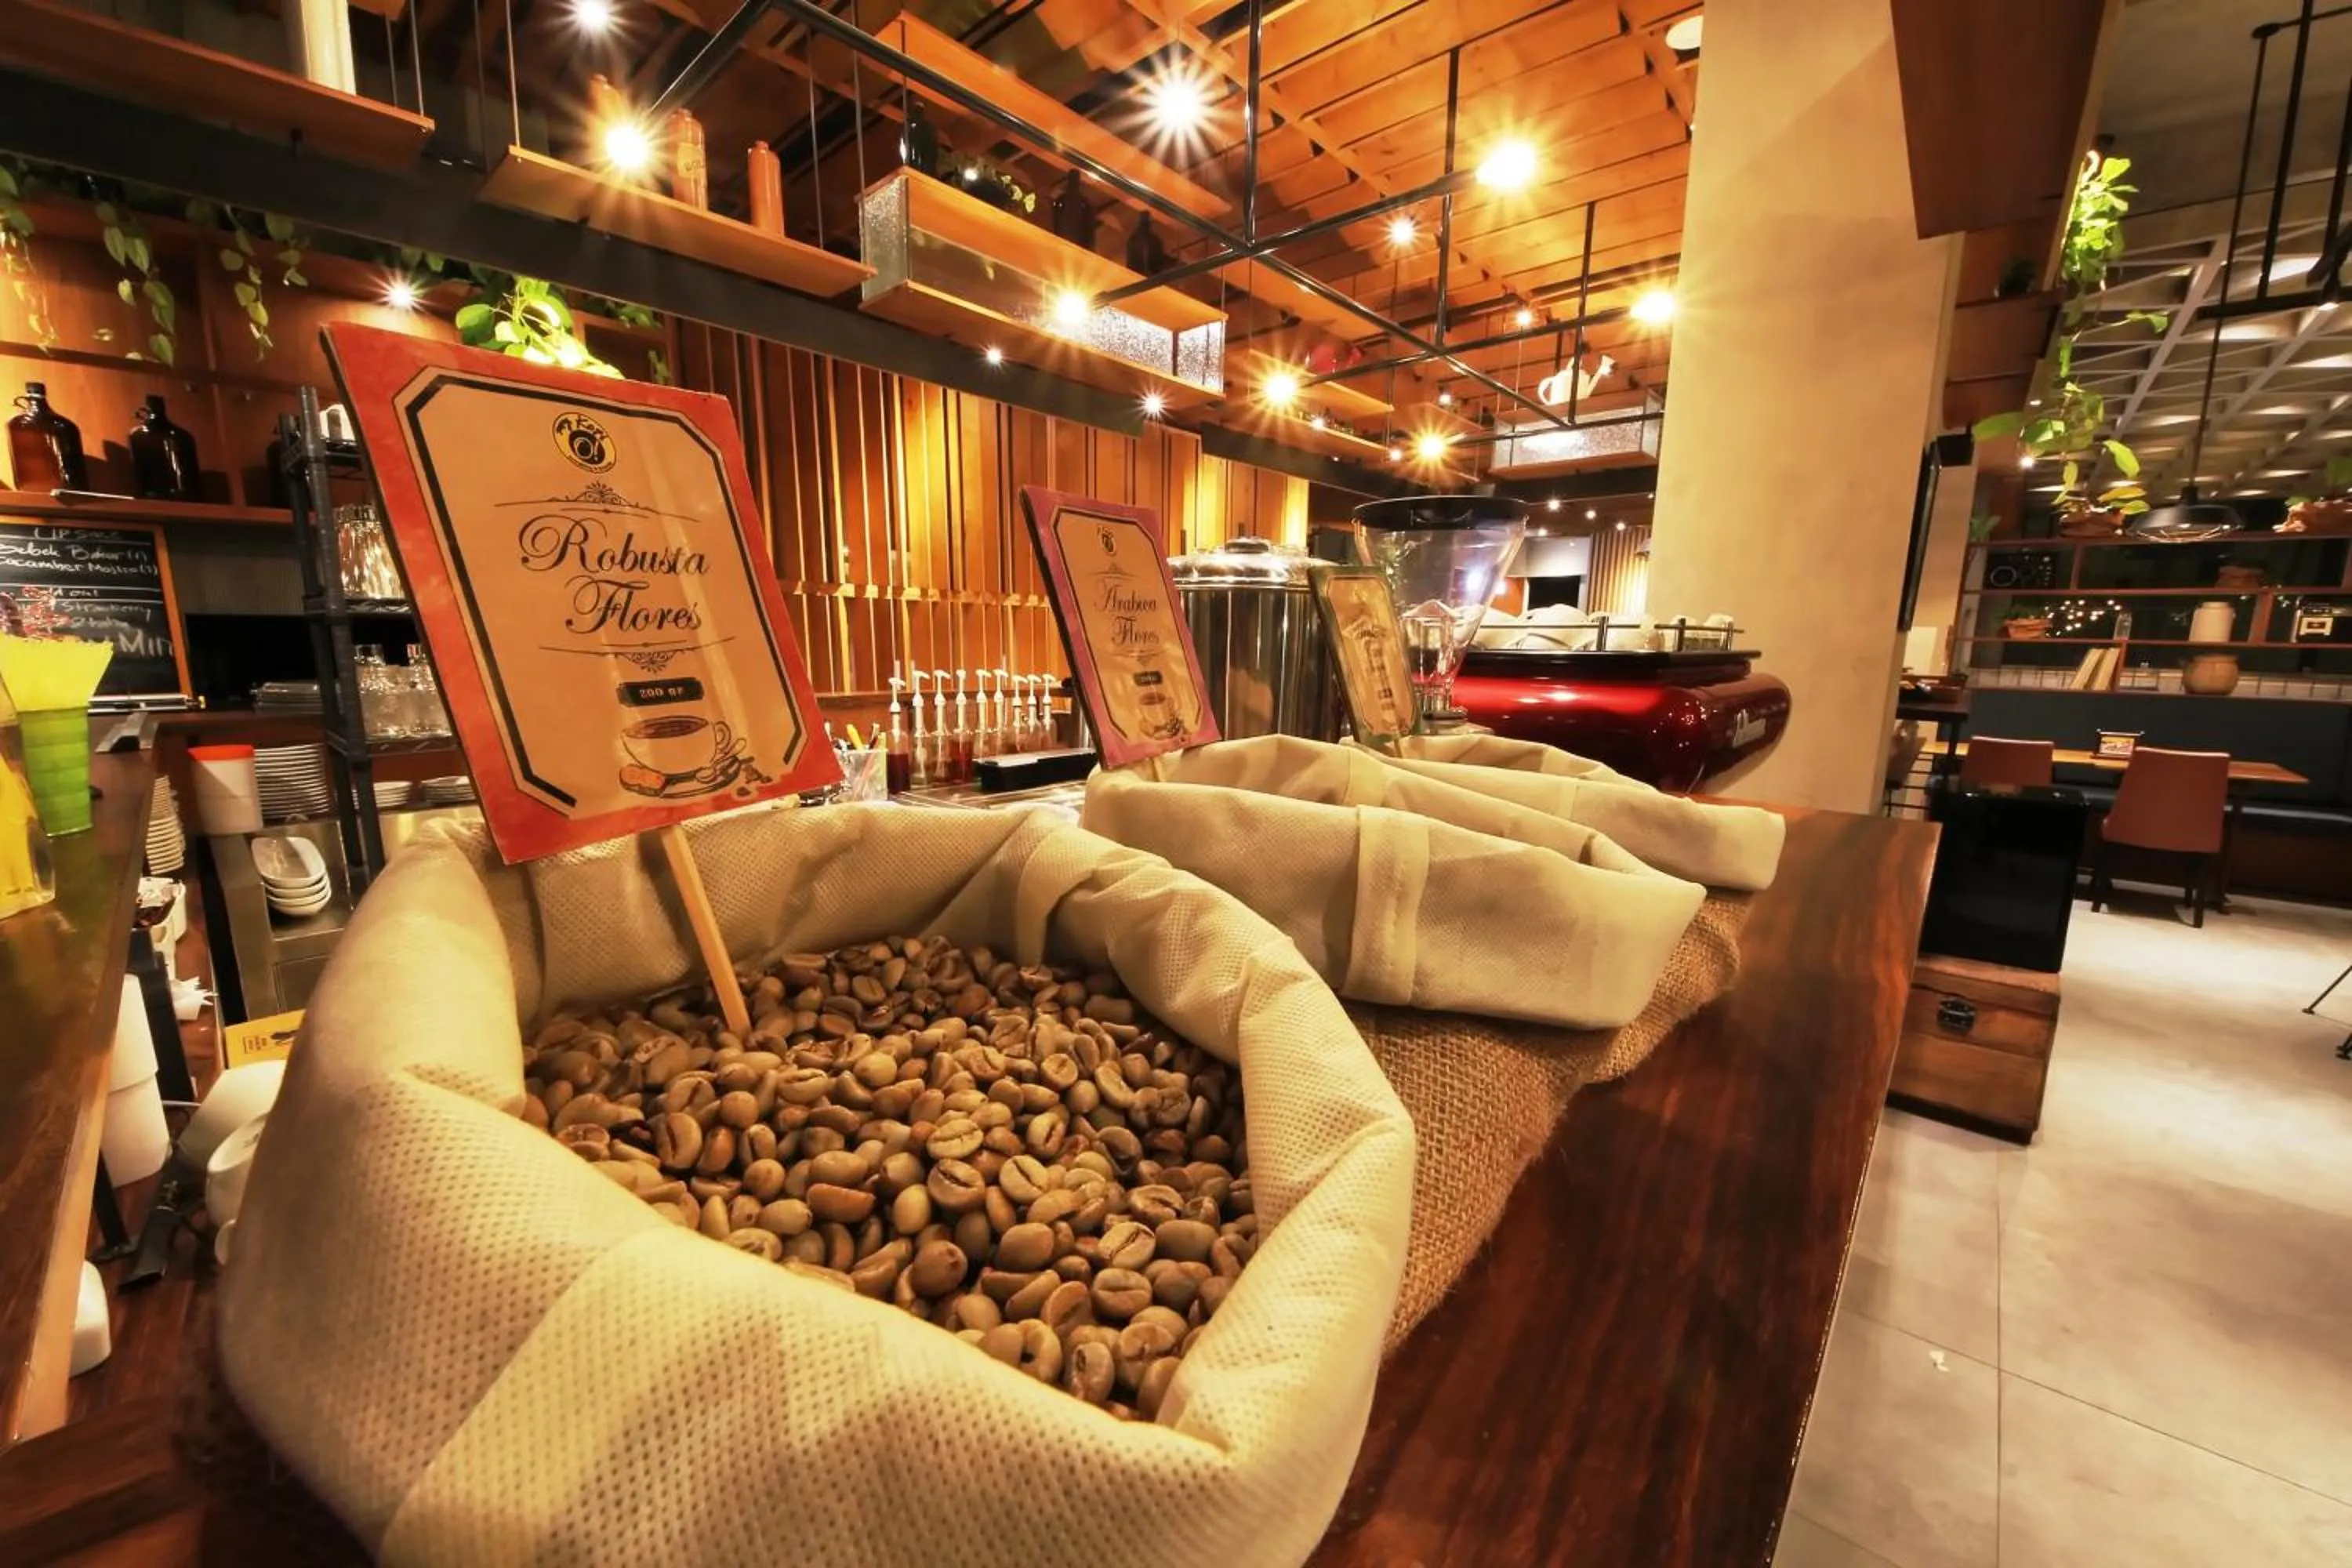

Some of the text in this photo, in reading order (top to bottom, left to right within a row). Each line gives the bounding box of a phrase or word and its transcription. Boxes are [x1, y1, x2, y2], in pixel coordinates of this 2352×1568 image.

[518, 514, 710, 575] Robusta
[564, 575, 703, 634] Flores
[639, 687, 664, 699] 200
